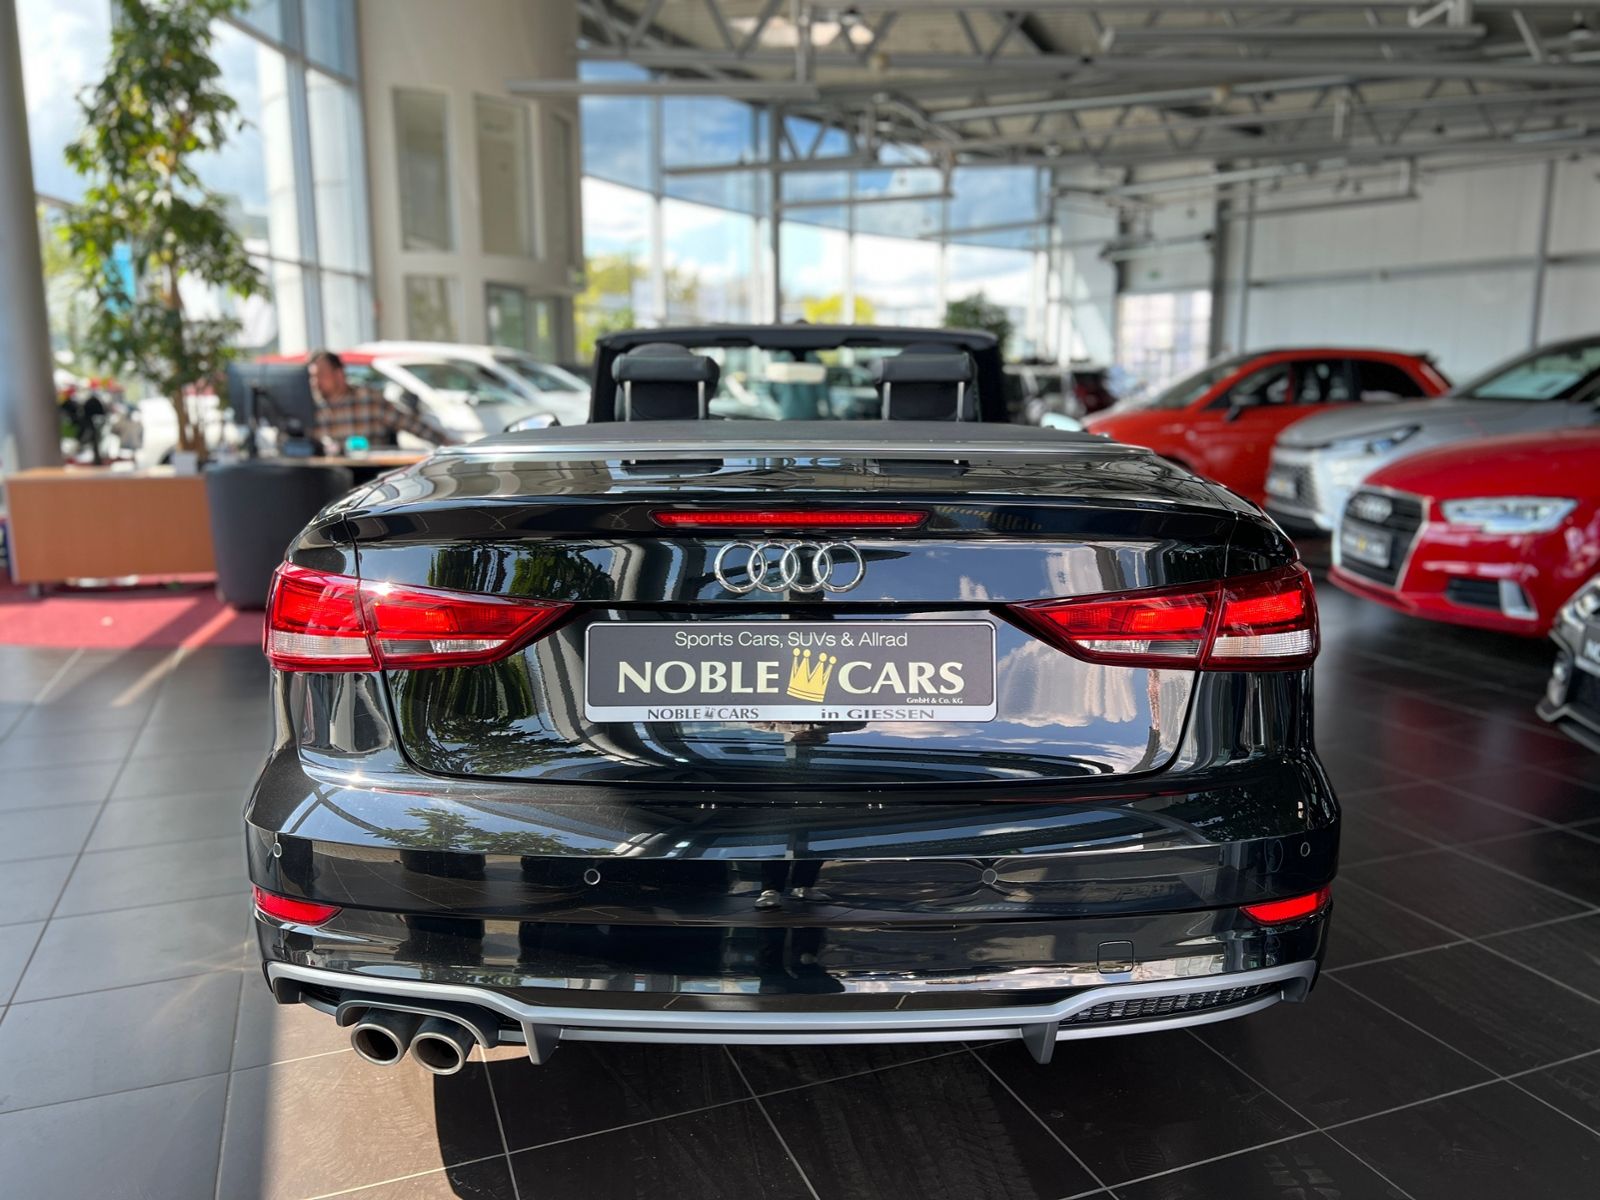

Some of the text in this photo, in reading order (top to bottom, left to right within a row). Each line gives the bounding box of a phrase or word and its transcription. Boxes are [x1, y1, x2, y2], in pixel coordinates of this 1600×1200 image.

[675, 631, 908, 649] Sports Cars, SUVs & Allrad
[618, 661, 965, 695] NOBLE CARS
[648, 708, 759, 720] NOBLE CARS
[821, 708, 935, 720] in GIESSEN
